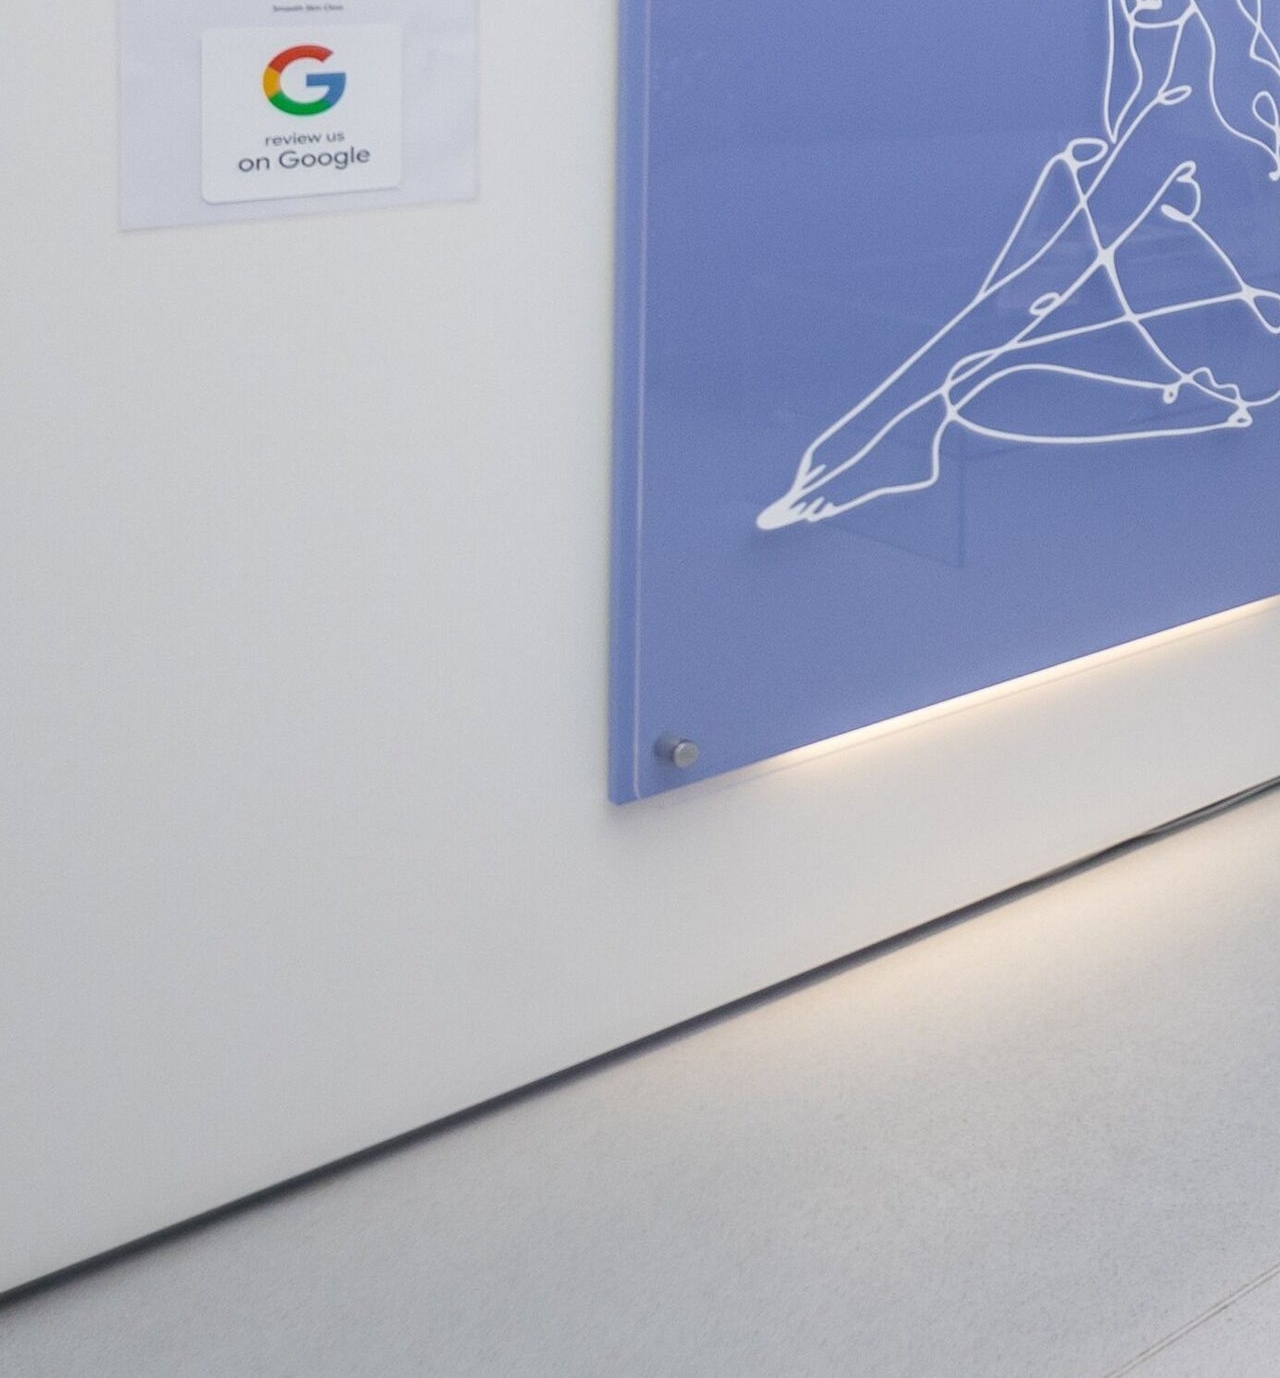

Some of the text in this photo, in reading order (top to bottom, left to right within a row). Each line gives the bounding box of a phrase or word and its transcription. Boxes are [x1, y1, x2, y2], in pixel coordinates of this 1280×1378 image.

[263, 44, 347, 116] G
[265, 132, 345, 147] review us
[238, 146, 370, 173] on Google
